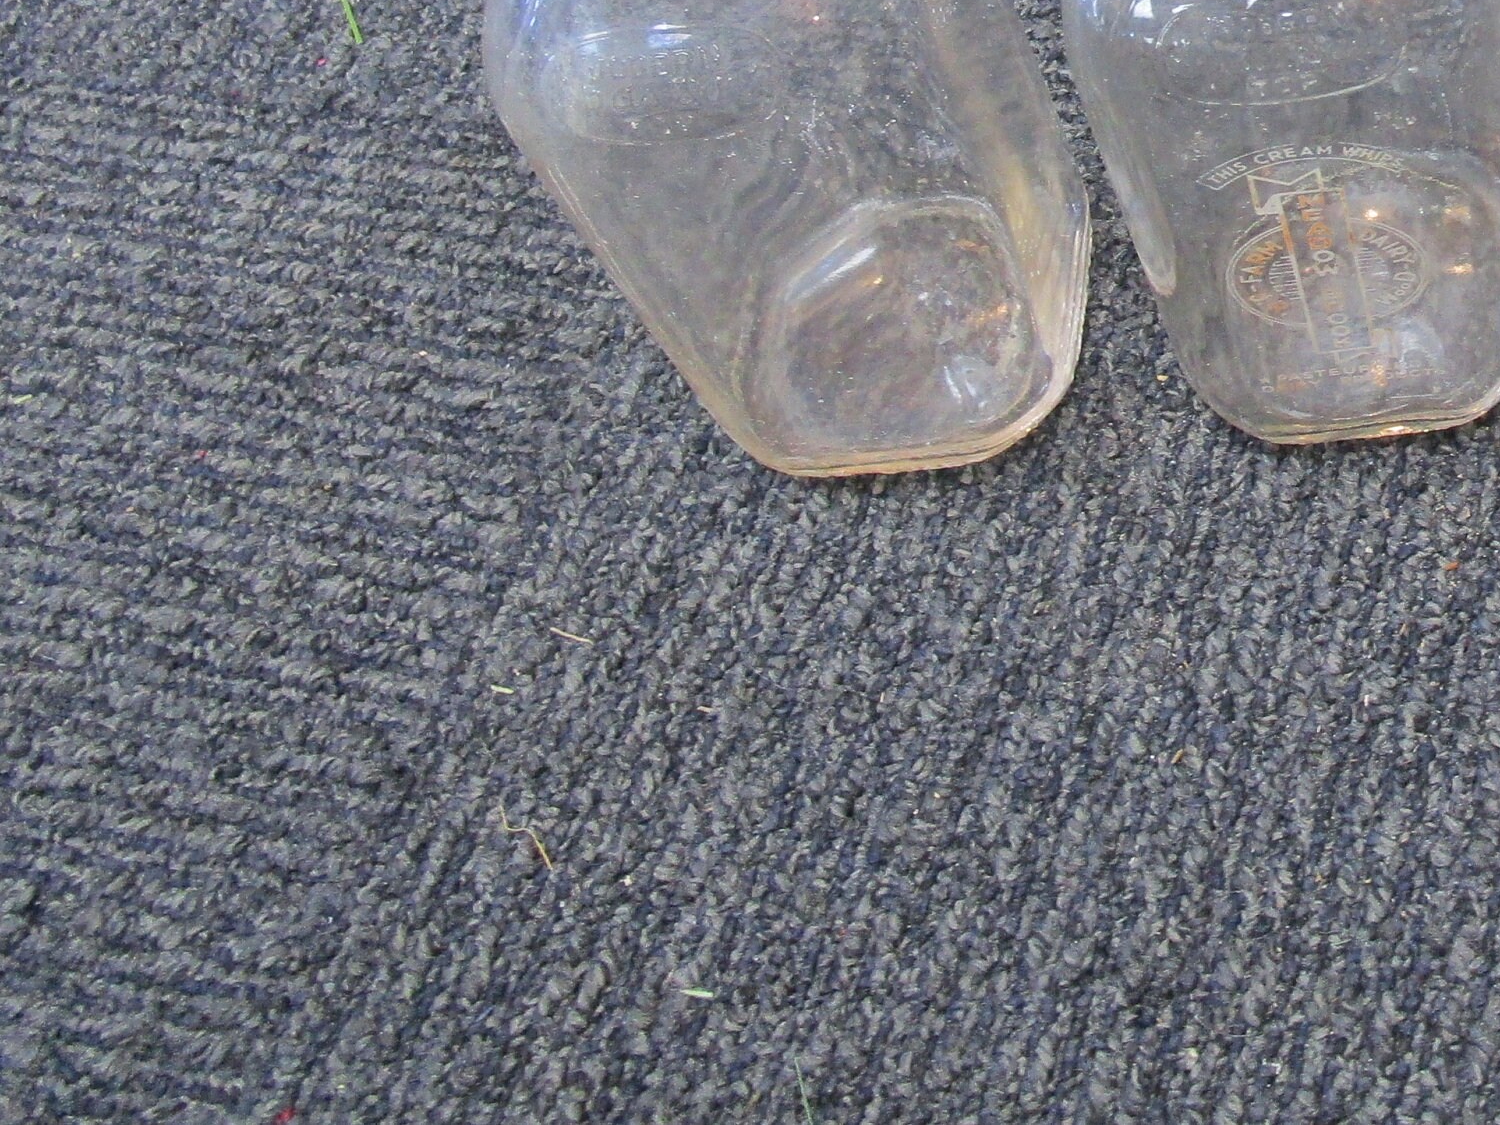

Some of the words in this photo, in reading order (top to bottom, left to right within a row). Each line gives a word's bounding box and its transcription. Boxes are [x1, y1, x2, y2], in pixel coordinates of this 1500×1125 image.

[1207, 161, 1248, 184] THIS
[1253, 145, 1332, 165] CREAM
[1342, 146, 1406, 169] WHIPS
